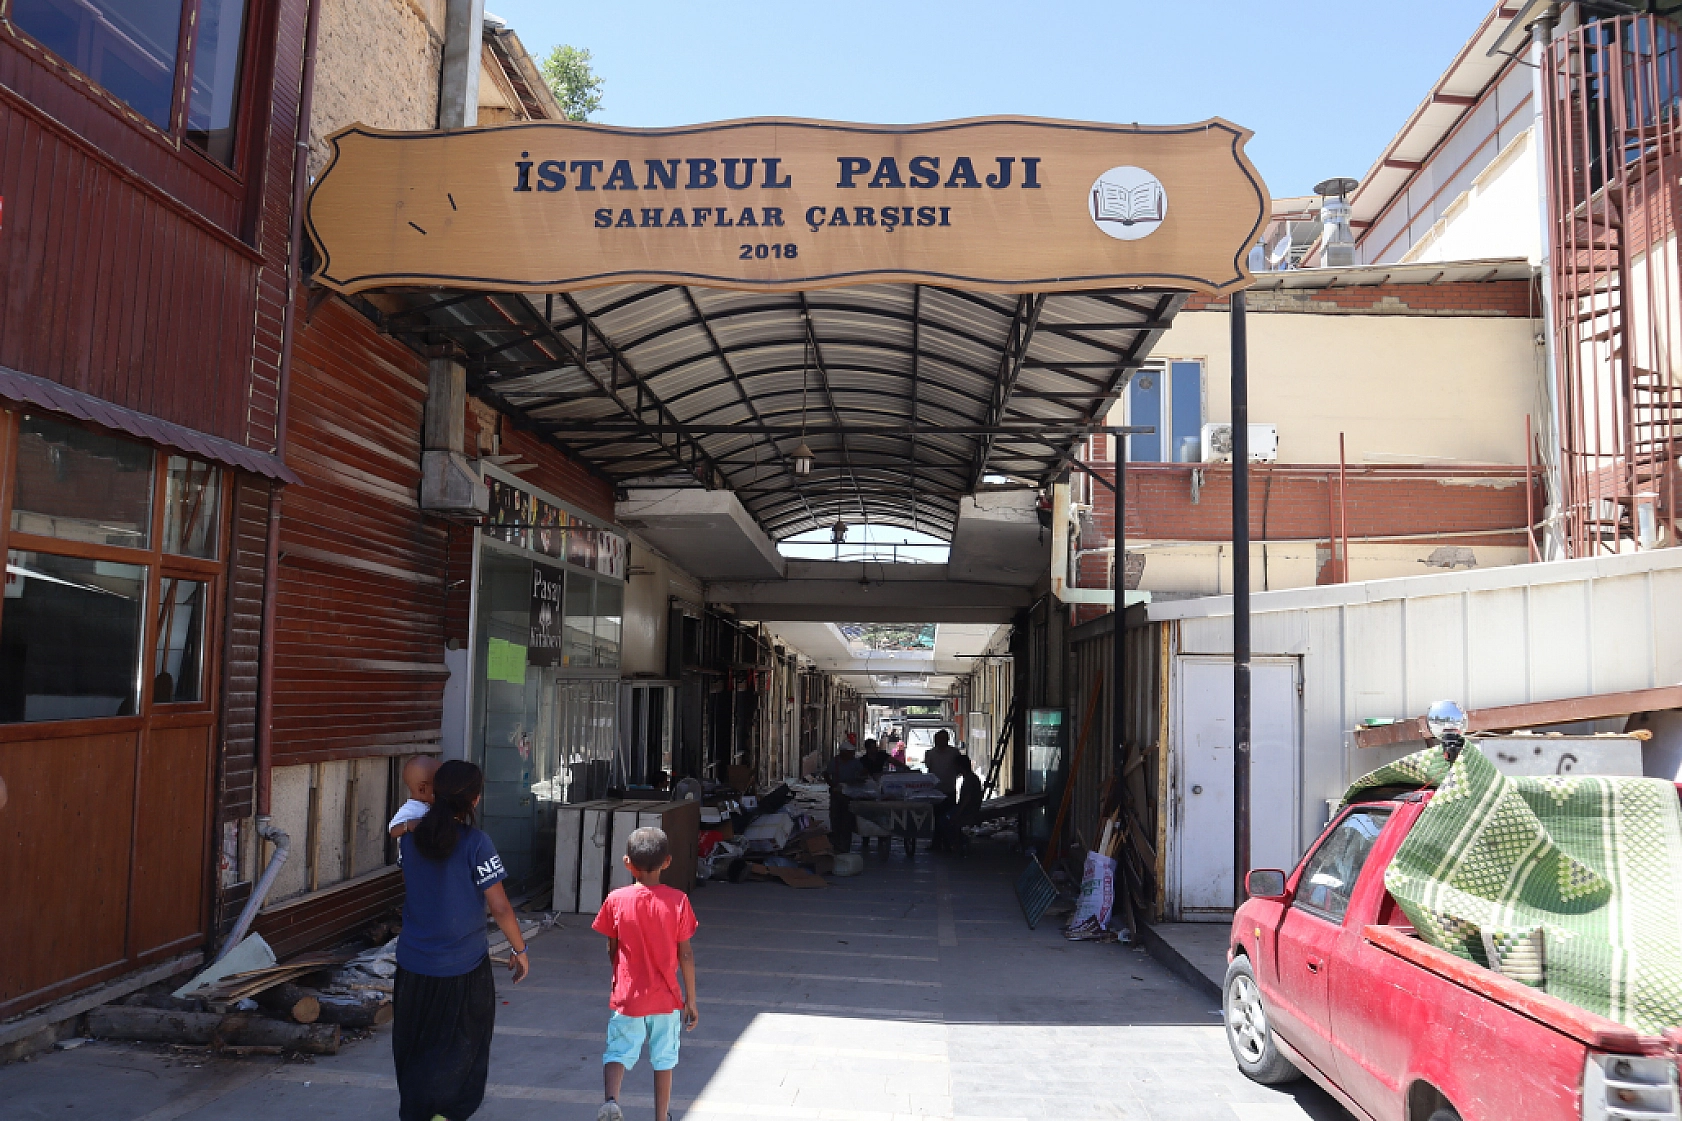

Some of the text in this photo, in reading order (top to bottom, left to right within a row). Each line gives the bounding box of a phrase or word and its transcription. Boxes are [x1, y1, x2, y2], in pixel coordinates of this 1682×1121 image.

[512, 151, 1042, 193] İSTANBUL PASAJI
[594, 205, 952, 233] SAHAFLAR ÇARŞISI
[738, 243, 799, 260] 2018
[532, 568, 562, 612] Pasaj
